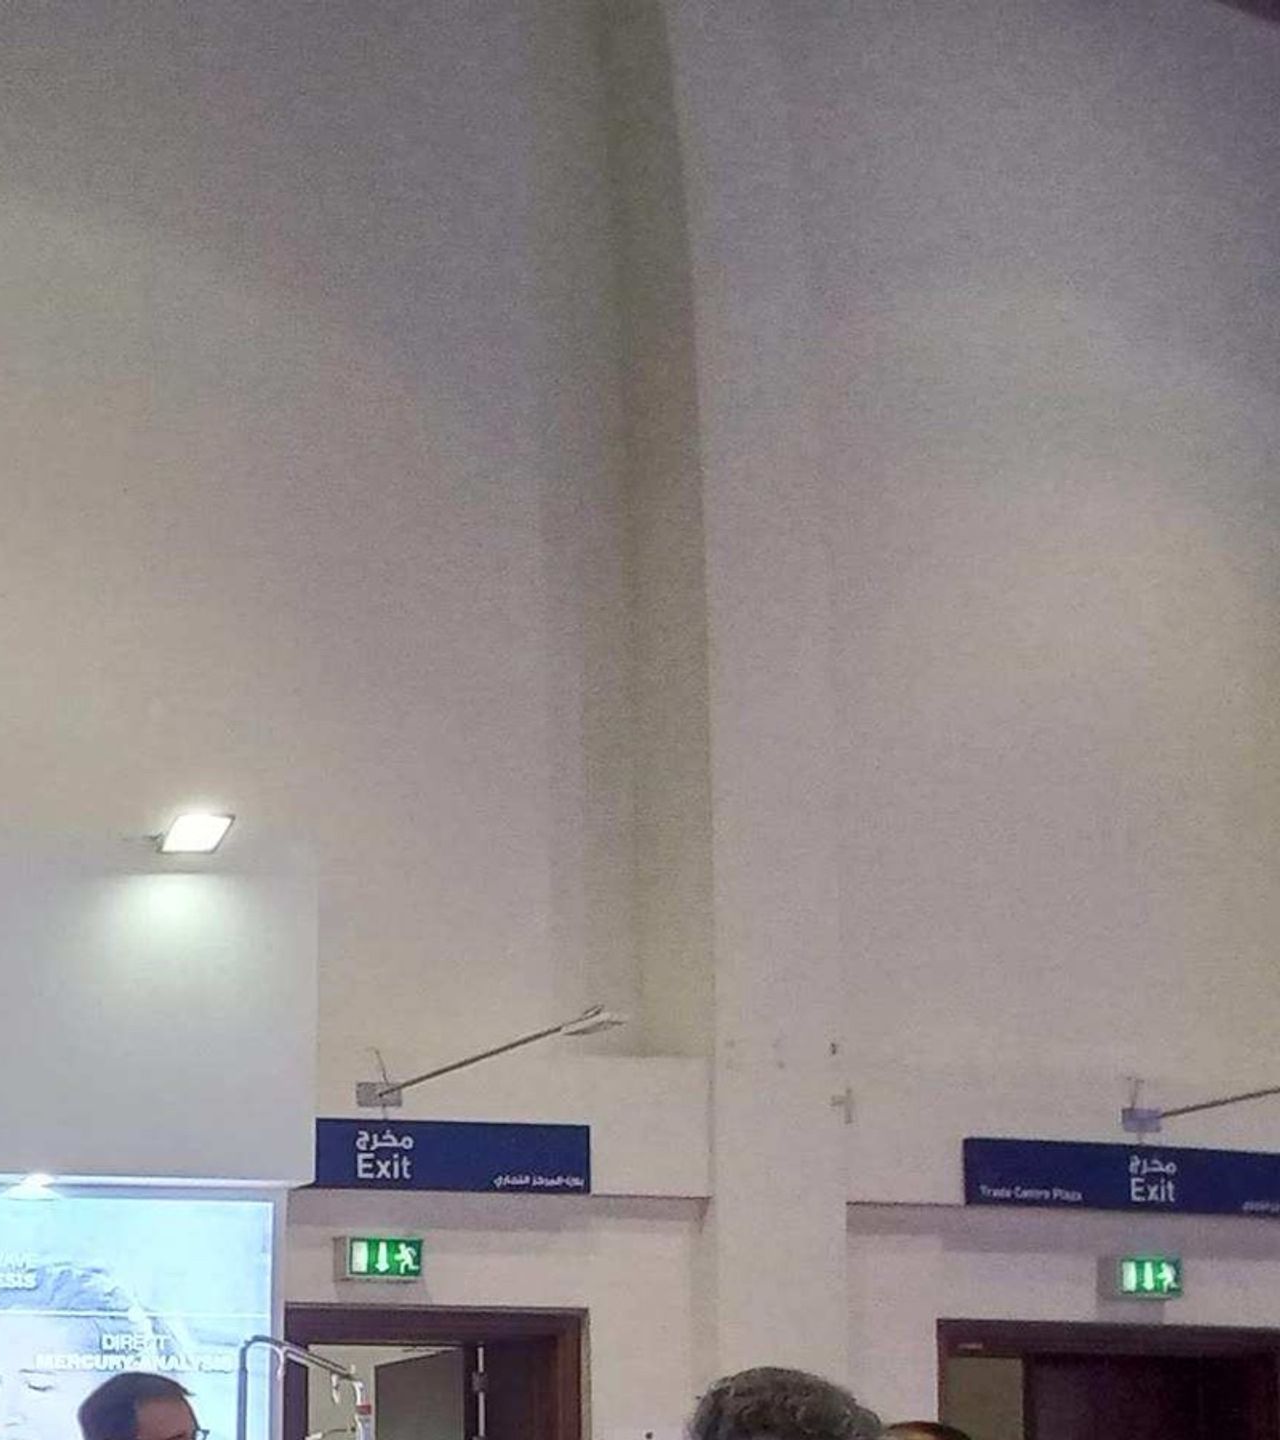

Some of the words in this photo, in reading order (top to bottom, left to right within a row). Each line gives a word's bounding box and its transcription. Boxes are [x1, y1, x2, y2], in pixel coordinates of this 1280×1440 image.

[355, 1129, 415, 1151] مخرج
[356, 1153, 412, 1179] Exit
[1130, 1177, 1176, 1202] Exit
[101, 1333, 170, 1351] DIRECT
[35, 1354, 127, 1372] MERCURY
